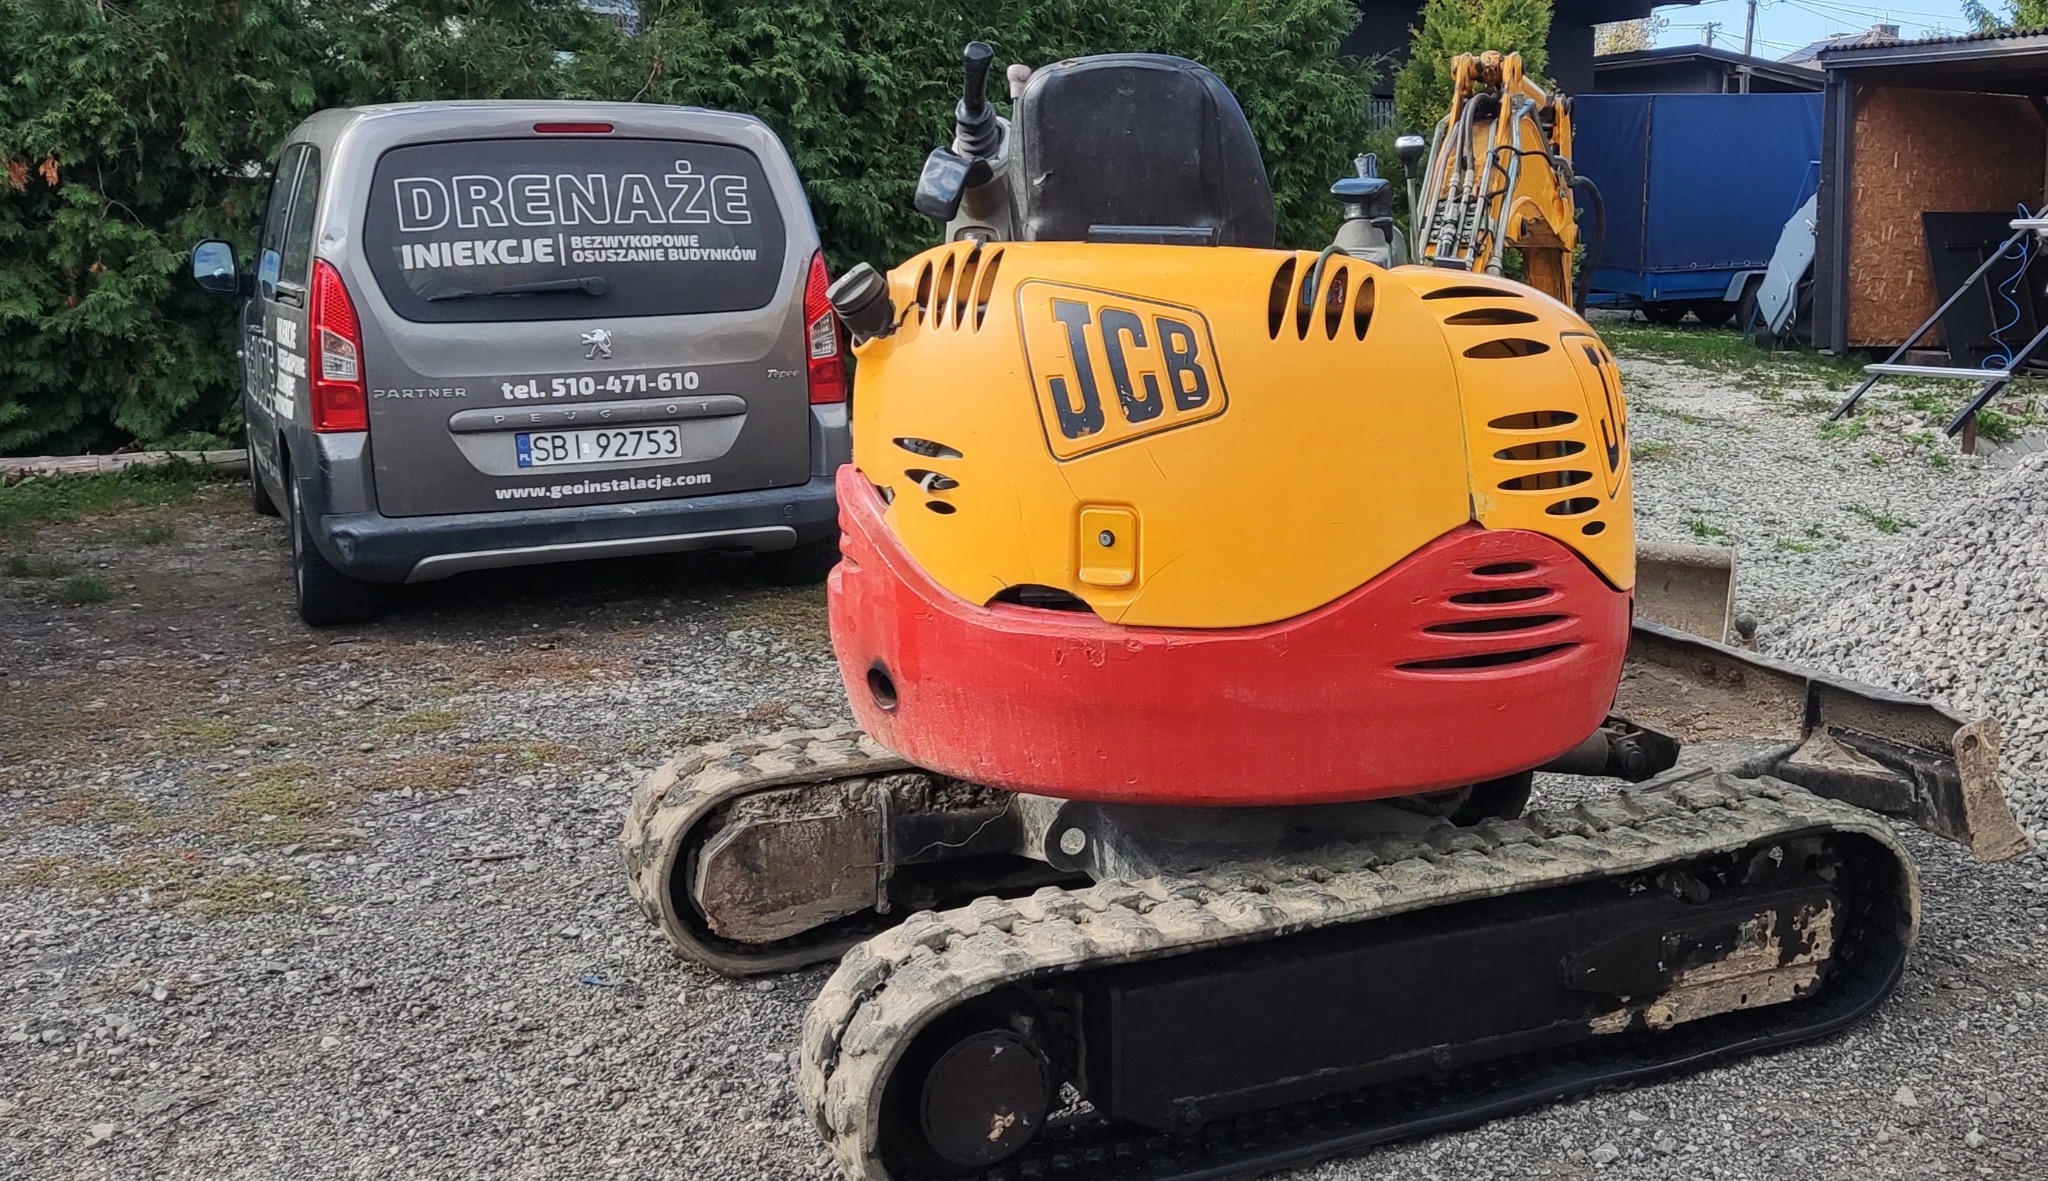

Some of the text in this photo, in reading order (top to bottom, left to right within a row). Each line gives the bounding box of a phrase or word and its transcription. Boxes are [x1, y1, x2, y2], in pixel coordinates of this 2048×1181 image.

[393, 160, 752, 232] DRENAŻE
[570, 234, 700, 249] BEZWYKOPOWE
[402, 238, 555, 270] INIEKCJE
[572, 245, 757, 263] OSUSZANIE BUDYNKÓW
[766, 368, 799, 379] Tepee
[1048, 299, 1210, 440] JCB
[373, 387, 467, 399] PARTNER
[501, 371, 699, 400] tel. 510-471-610
[493, 402, 709, 424] PEUGOT
[519, 453, 530, 462] PL
[533, 429, 678, 462] SBI 92753
[495, 473, 711, 499] www.geoinstalacje.com
